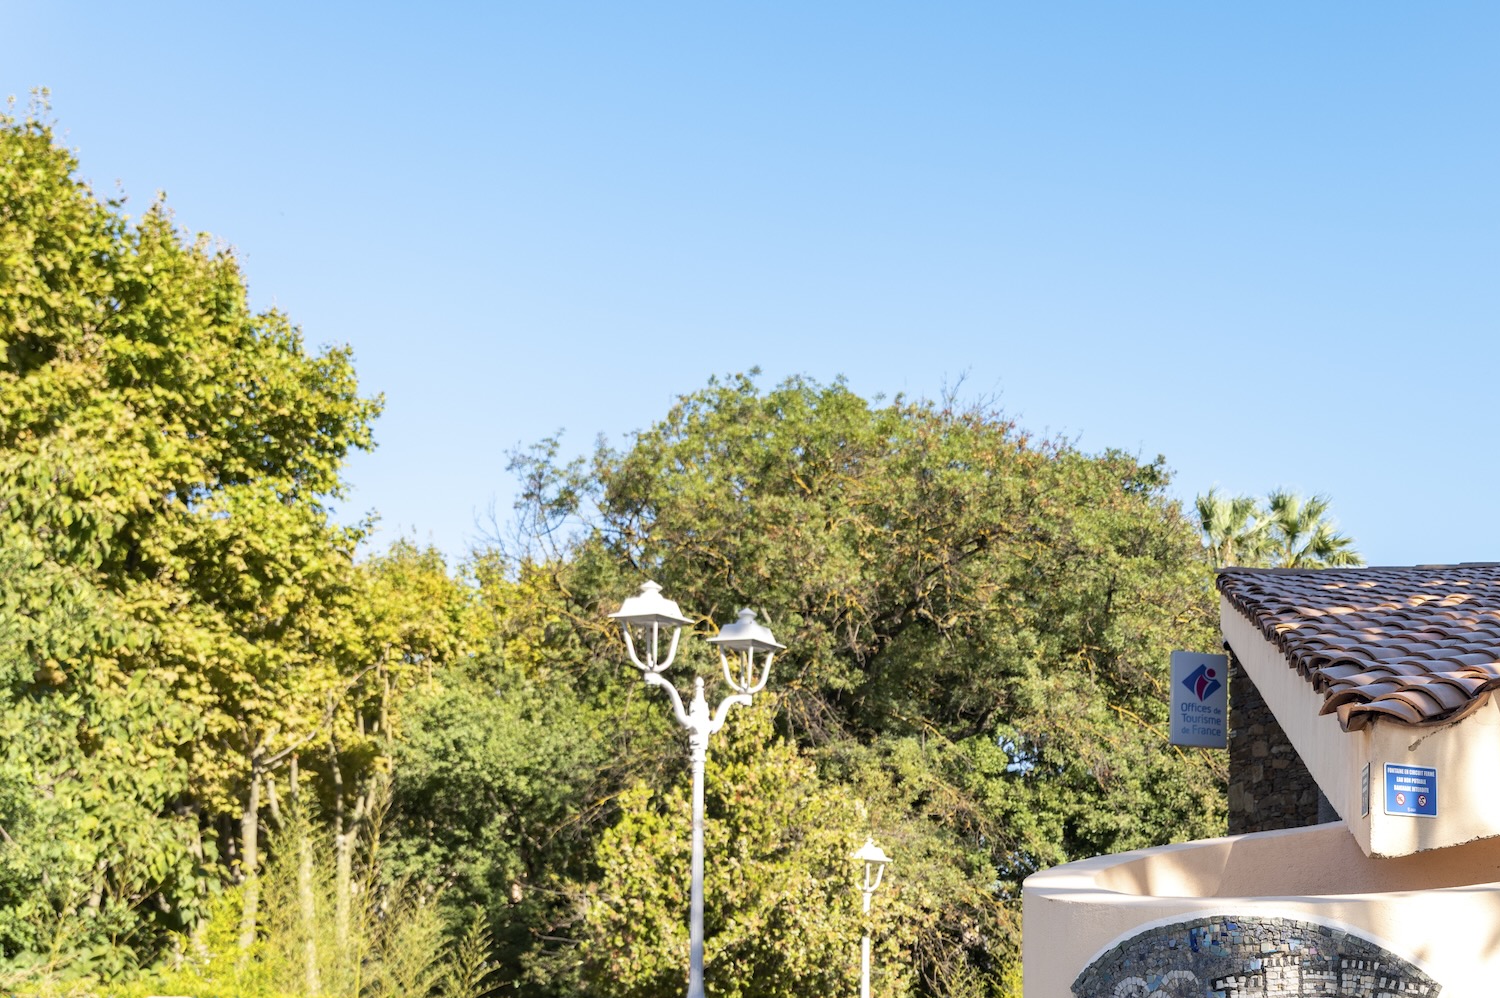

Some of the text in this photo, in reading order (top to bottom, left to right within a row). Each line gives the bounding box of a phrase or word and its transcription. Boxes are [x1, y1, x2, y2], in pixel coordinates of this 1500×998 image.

[1181, 702, 1212, 713] Offices
[1181, 714, 1222, 725] Tourisme
[1192, 725, 1222, 736] France
